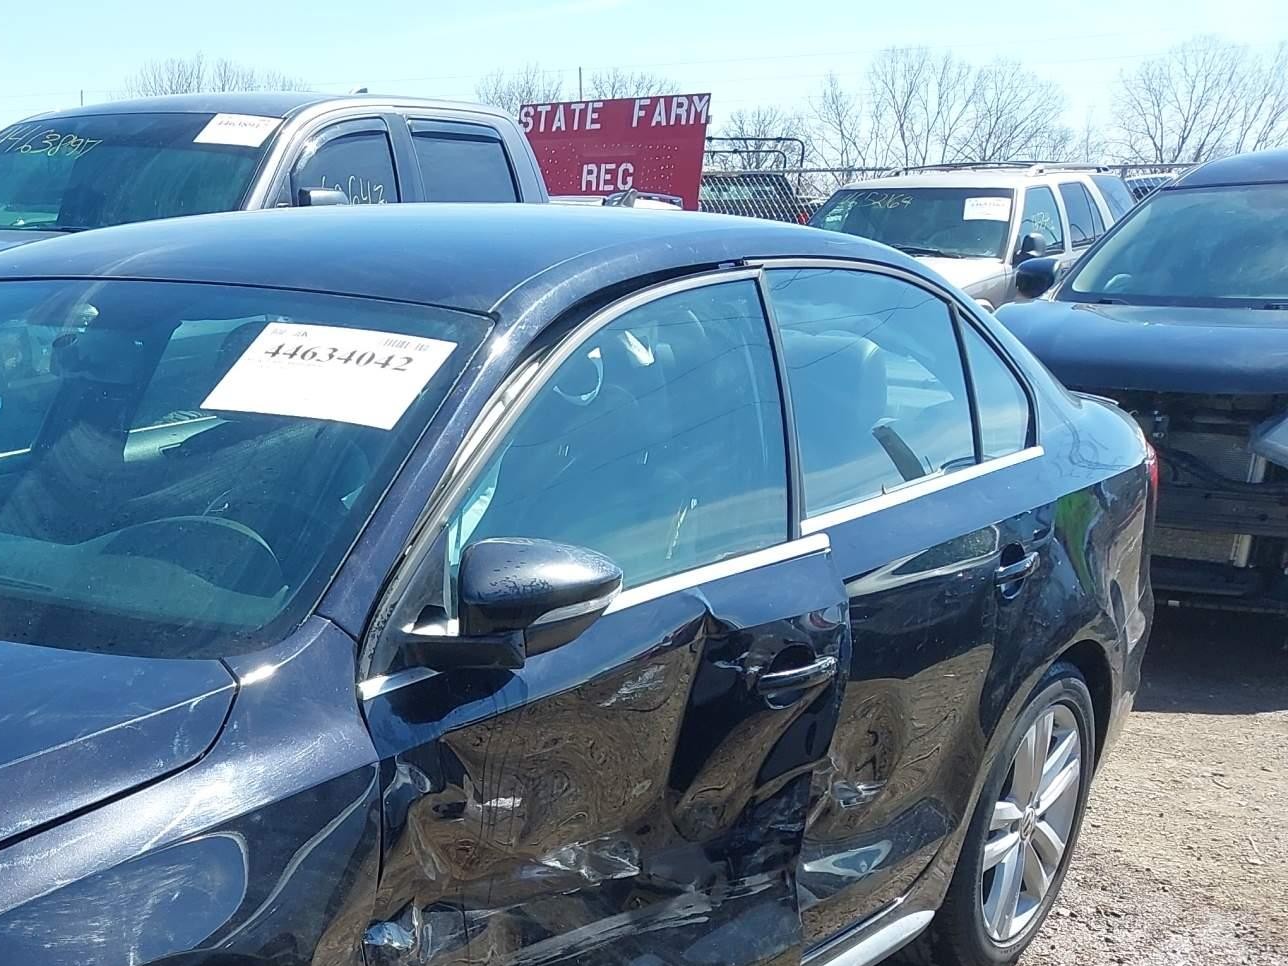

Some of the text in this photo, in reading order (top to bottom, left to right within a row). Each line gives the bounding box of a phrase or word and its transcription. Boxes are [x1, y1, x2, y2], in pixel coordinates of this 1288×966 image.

[519, 95, 711, 134] STATE FARM
[581, 162, 635, 192] REG
[264, 343, 415, 373] 44634042
